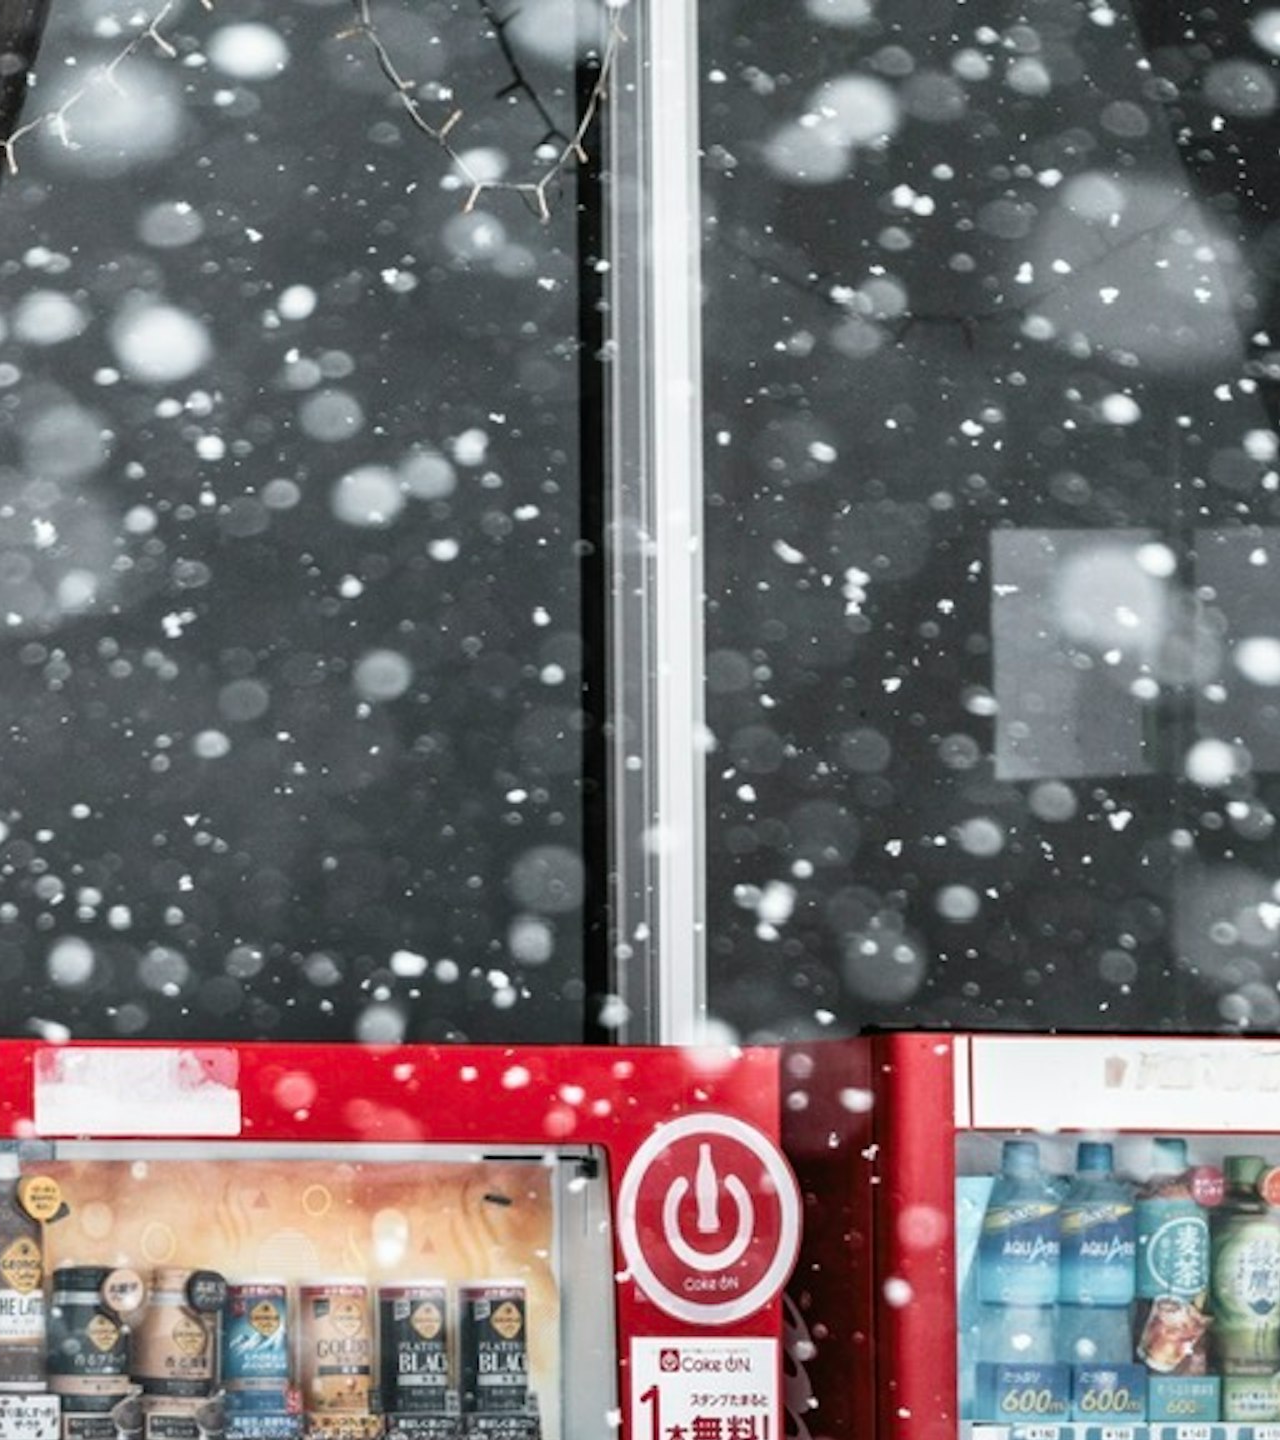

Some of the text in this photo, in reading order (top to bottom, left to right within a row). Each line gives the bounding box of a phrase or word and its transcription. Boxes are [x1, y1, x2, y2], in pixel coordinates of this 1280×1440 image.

[1175, 1223, 1201, 1288] 麦茶
[684, 1276, 739, 1291] Coke ON
[682, 1355, 751, 1373] Coke ON
[690, 1393, 768, 1408] スタンプたまると
